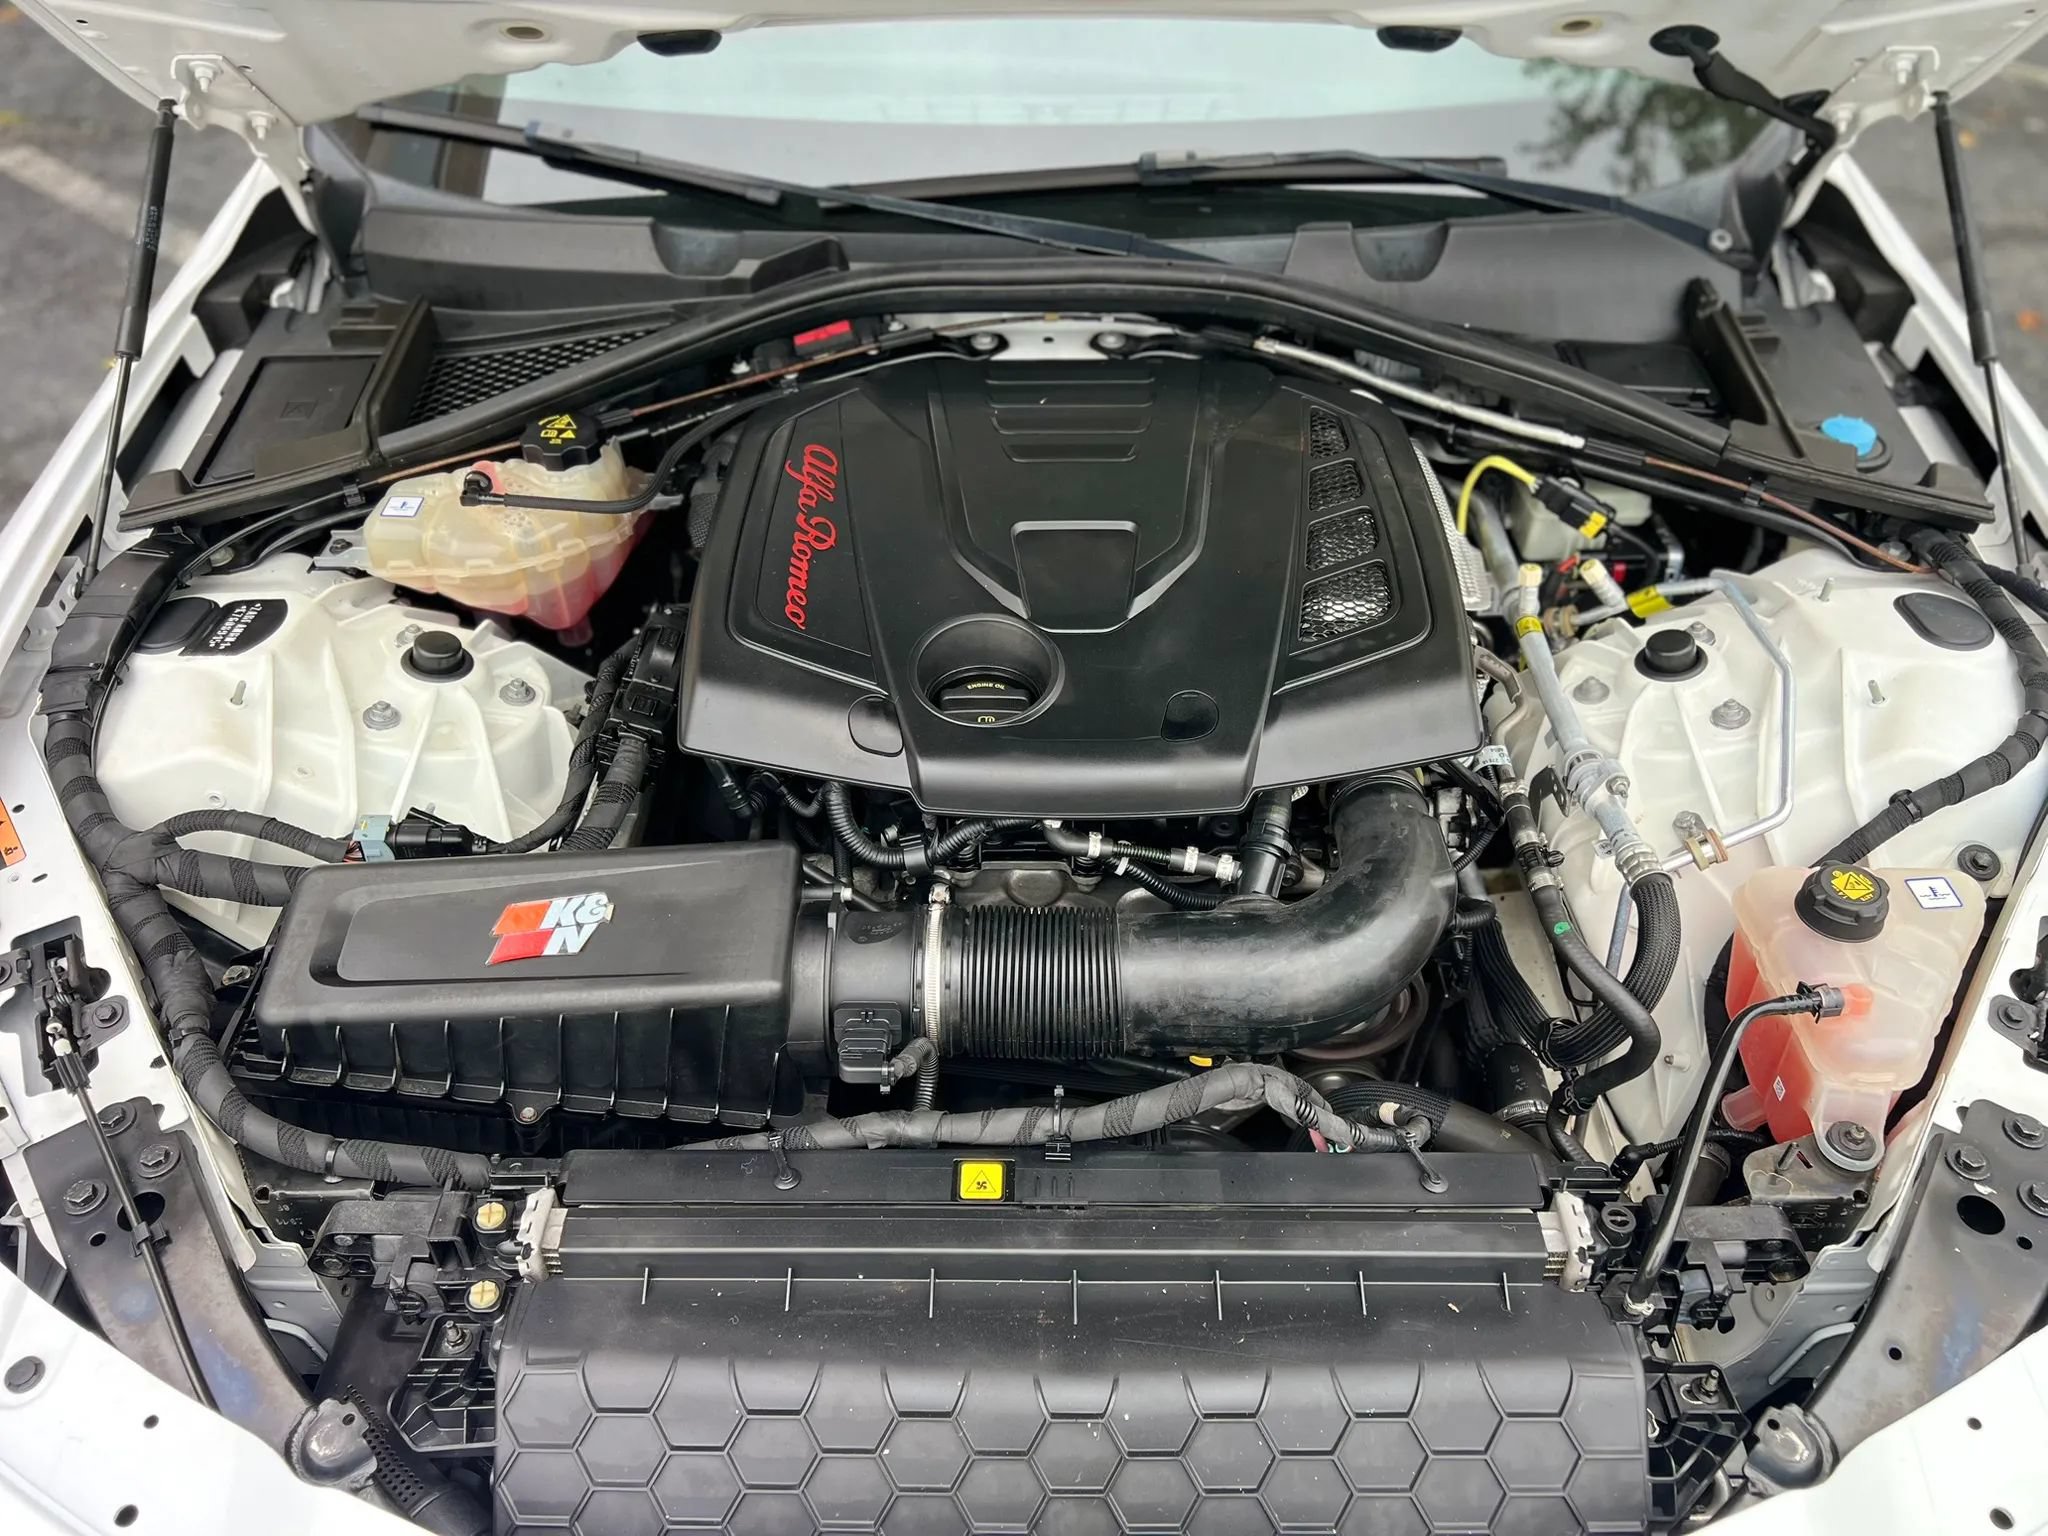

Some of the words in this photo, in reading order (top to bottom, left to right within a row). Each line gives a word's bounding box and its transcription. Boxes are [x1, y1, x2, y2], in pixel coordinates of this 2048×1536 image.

[785, 443, 839, 513] Alfa
[785, 512, 837, 630] Romeo
[966, 682, 994, 690] ENGINE
[994, 683, 1006, 691] OIL
